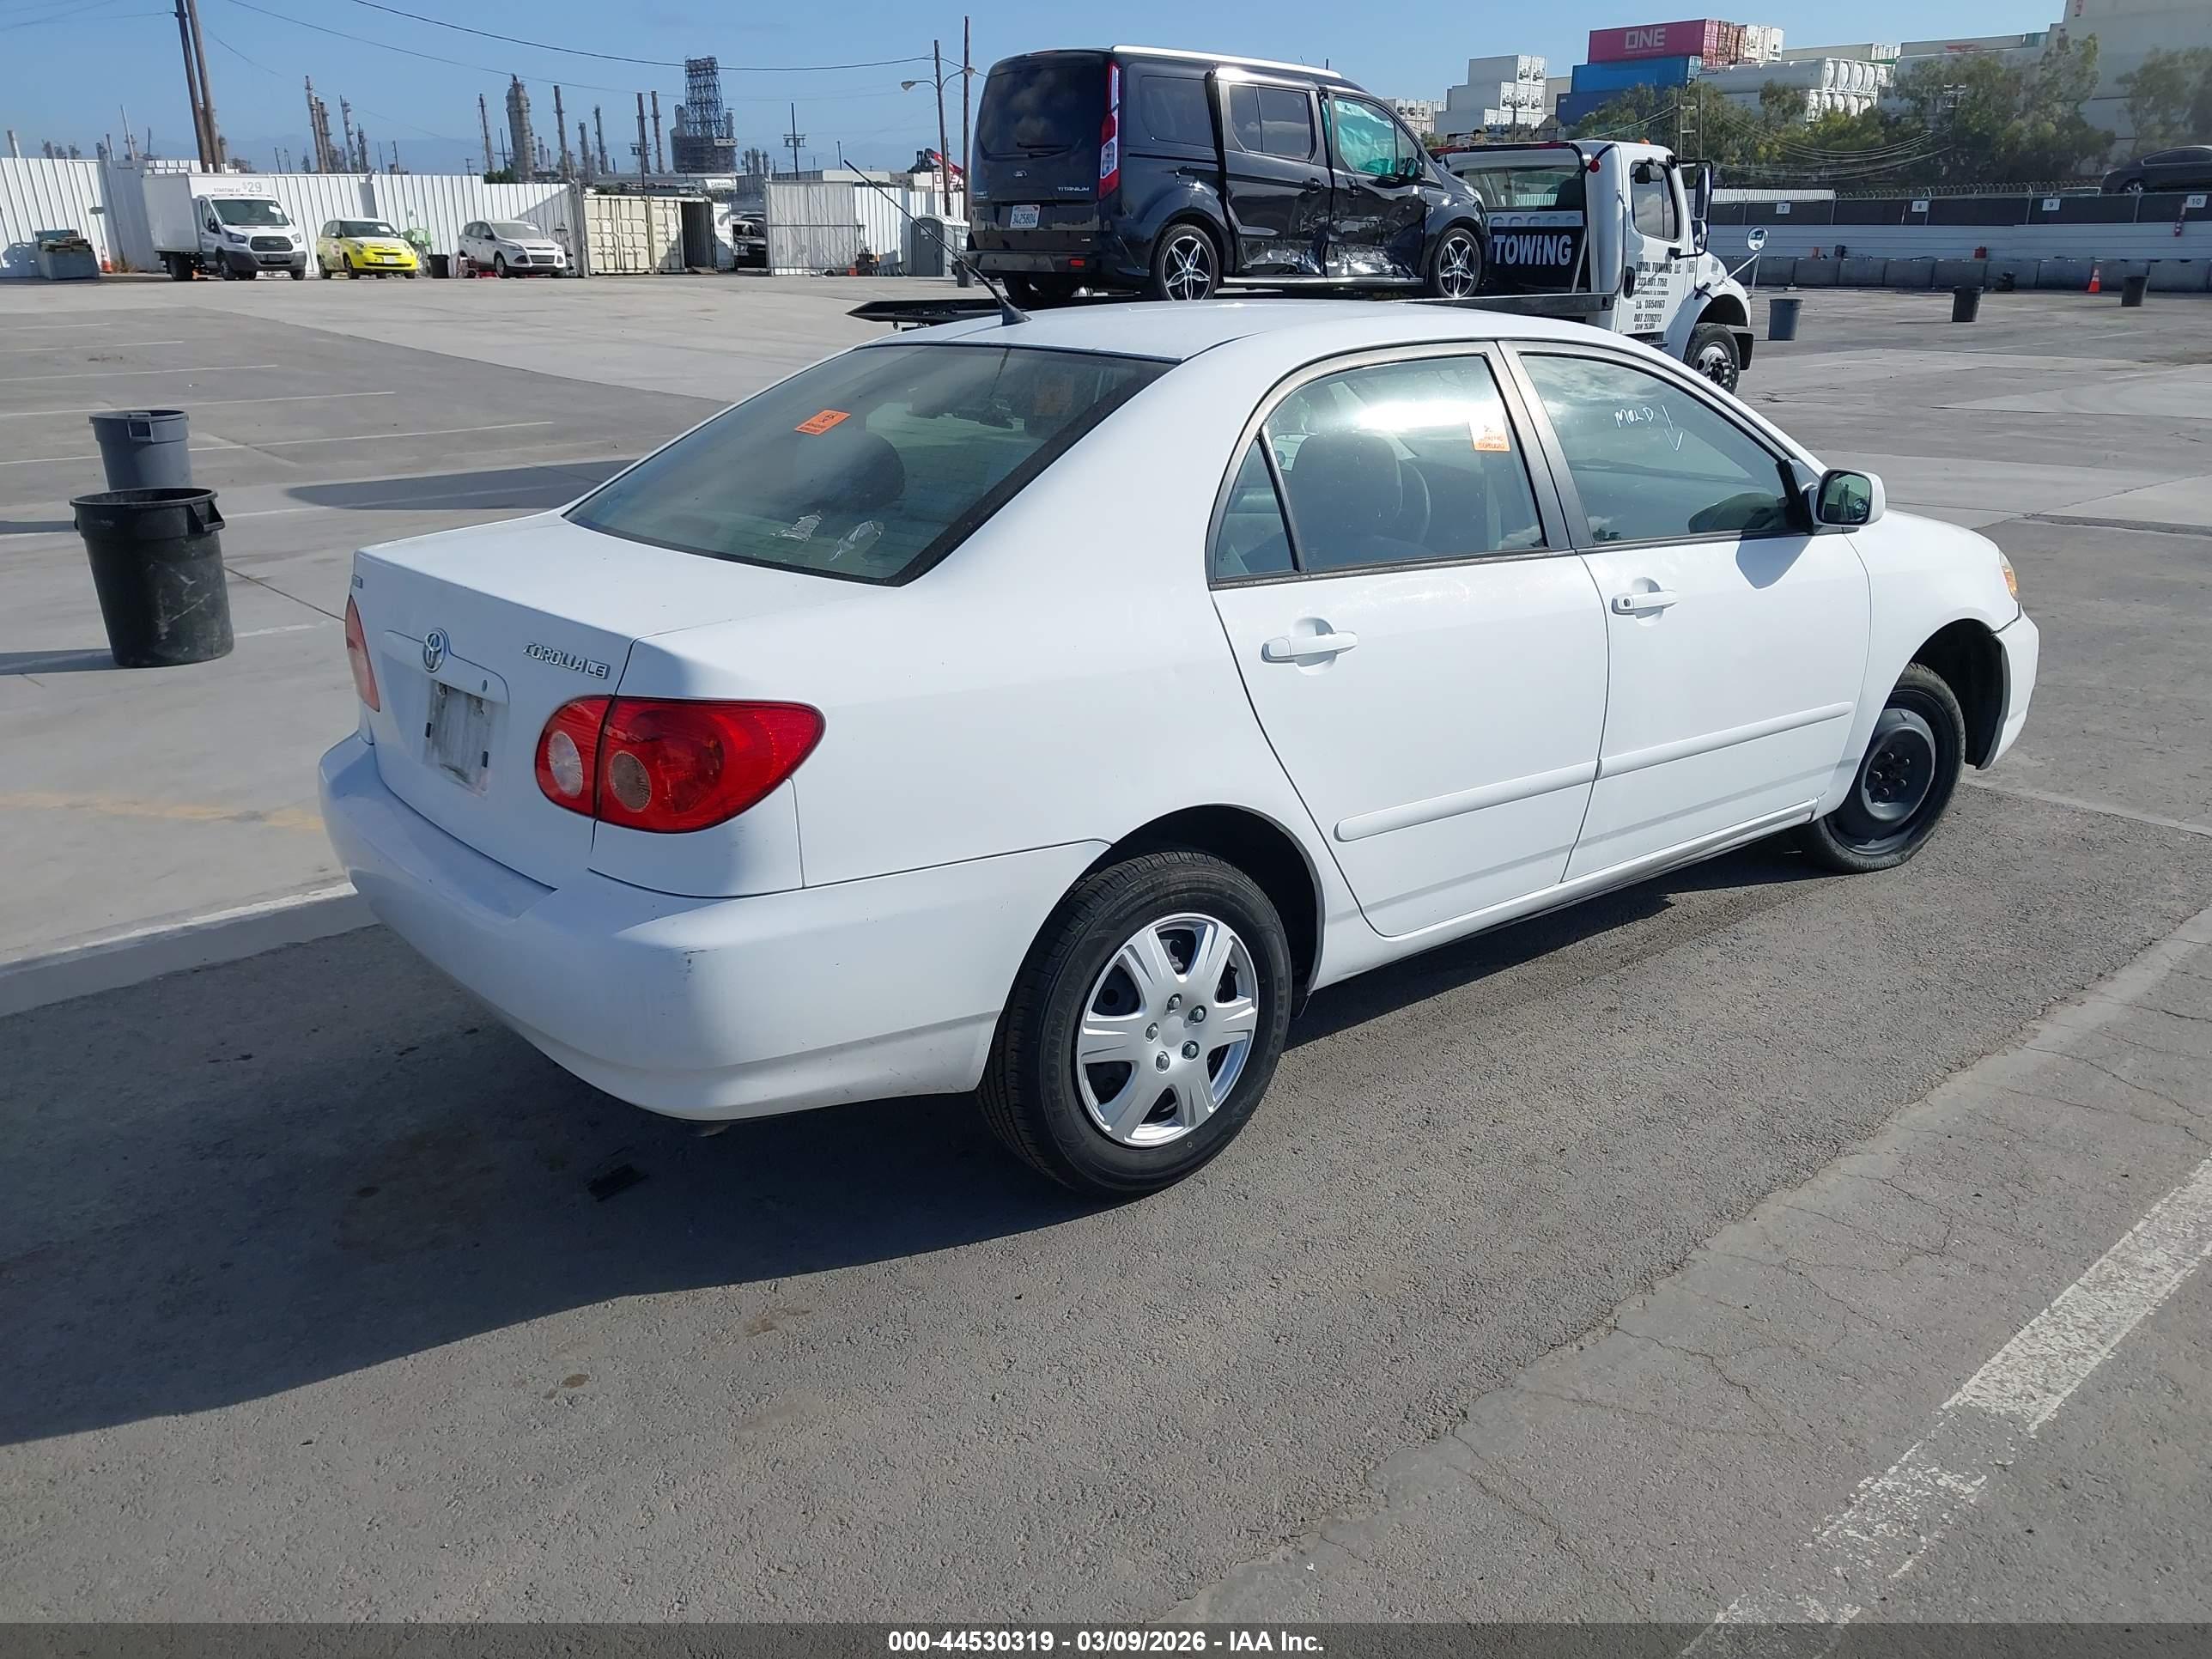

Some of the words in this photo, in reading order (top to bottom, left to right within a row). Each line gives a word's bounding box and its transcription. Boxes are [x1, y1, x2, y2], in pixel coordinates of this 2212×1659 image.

[1625, 27, 1667, 50] ONE
[2191, 198, 2203, 206] 10
[1493, 234, 1572, 266] TOWING
[1636, 261, 1650, 272] LOYAL
[1652, 262, 1672, 274] TOWING
[1634, 313, 1644, 322] DOT
[1614, 406, 1654, 428] MOLD
[522, 641, 587, 673] COROLLA
[586, 660, 610, 679] LE
